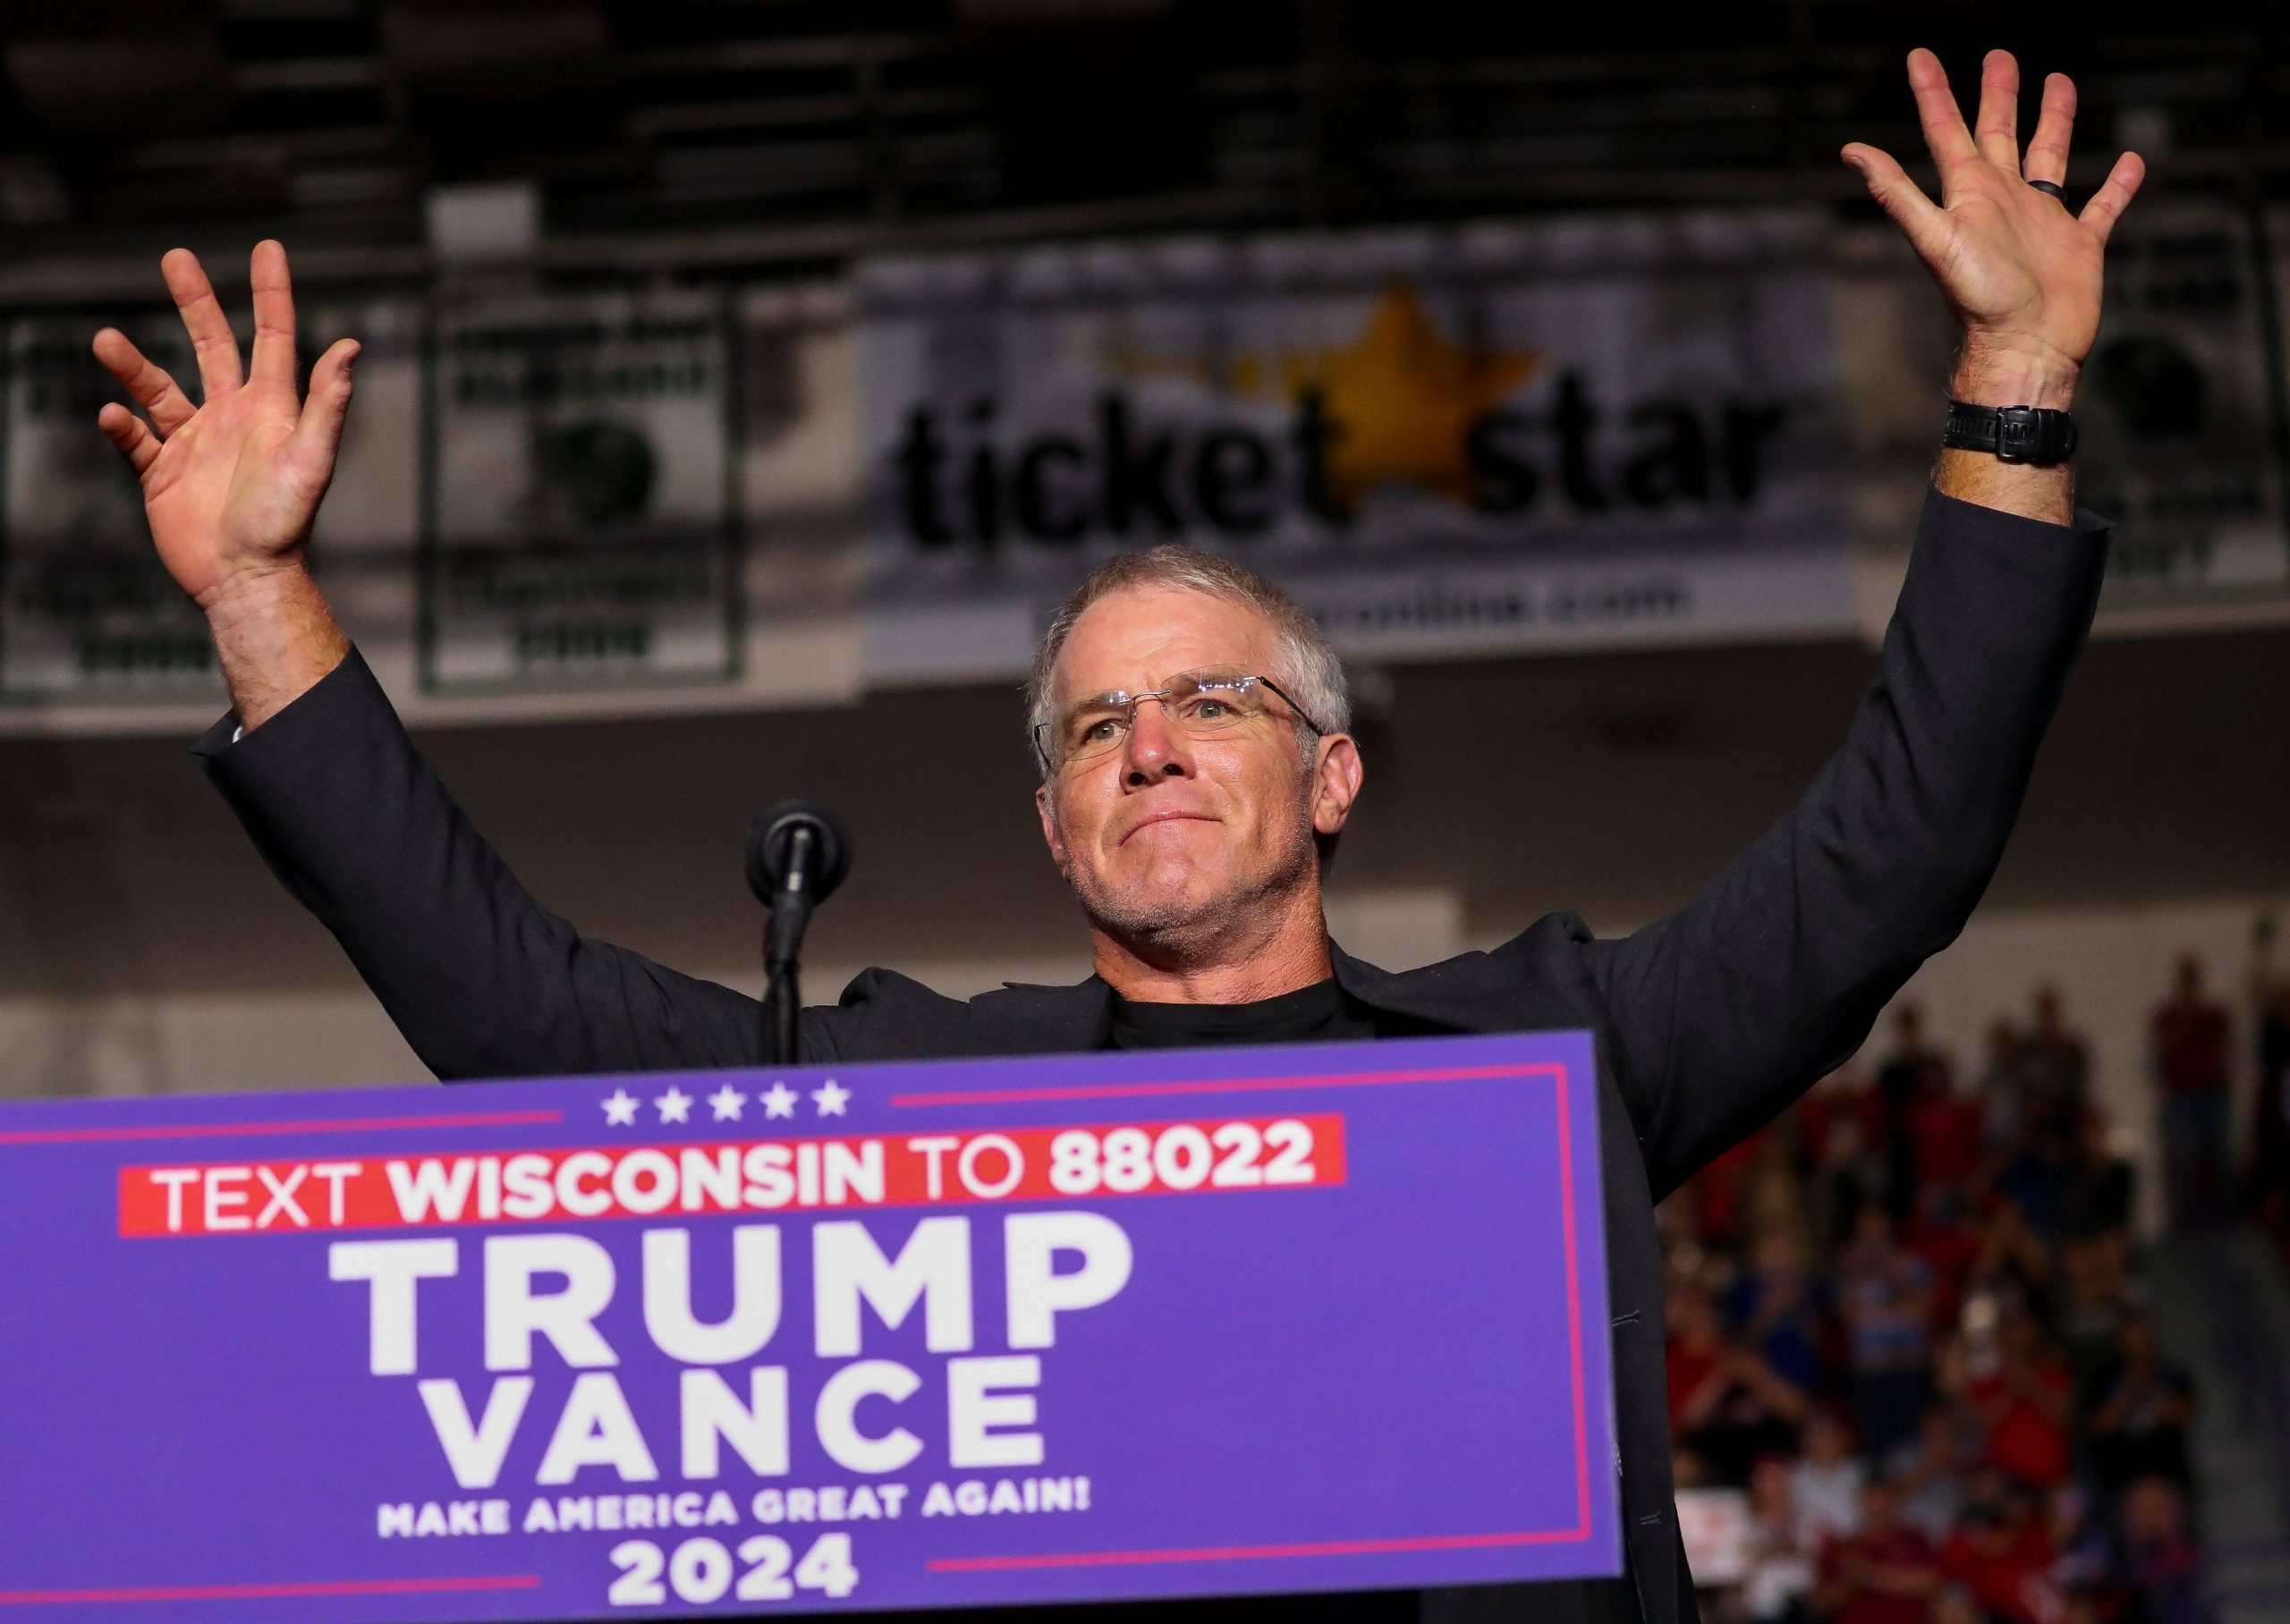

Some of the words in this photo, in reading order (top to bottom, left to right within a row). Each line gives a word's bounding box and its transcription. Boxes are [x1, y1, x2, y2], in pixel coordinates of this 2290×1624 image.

[902, 392, 1351, 544] ticket
[1469, 374, 1782, 512] star
[149, 1162, 363, 1231] TEXT
[385, 1140, 886, 1223] WISCONSIN
[907, 1134, 1025, 1199] TO
[1048, 1120, 1316, 1195] 88022
[327, 1211, 1134, 1376] TRUMP
[417, 1355, 1046, 1489] VANCE
[377, 1500, 510, 1538] MAKE
[523, 1492, 739, 1533] AMERICA
[751, 1484, 908, 1524] GREAT
[921, 1476, 1091, 1518] AGAIN!
[608, 1533, 860, 1606] 2024
